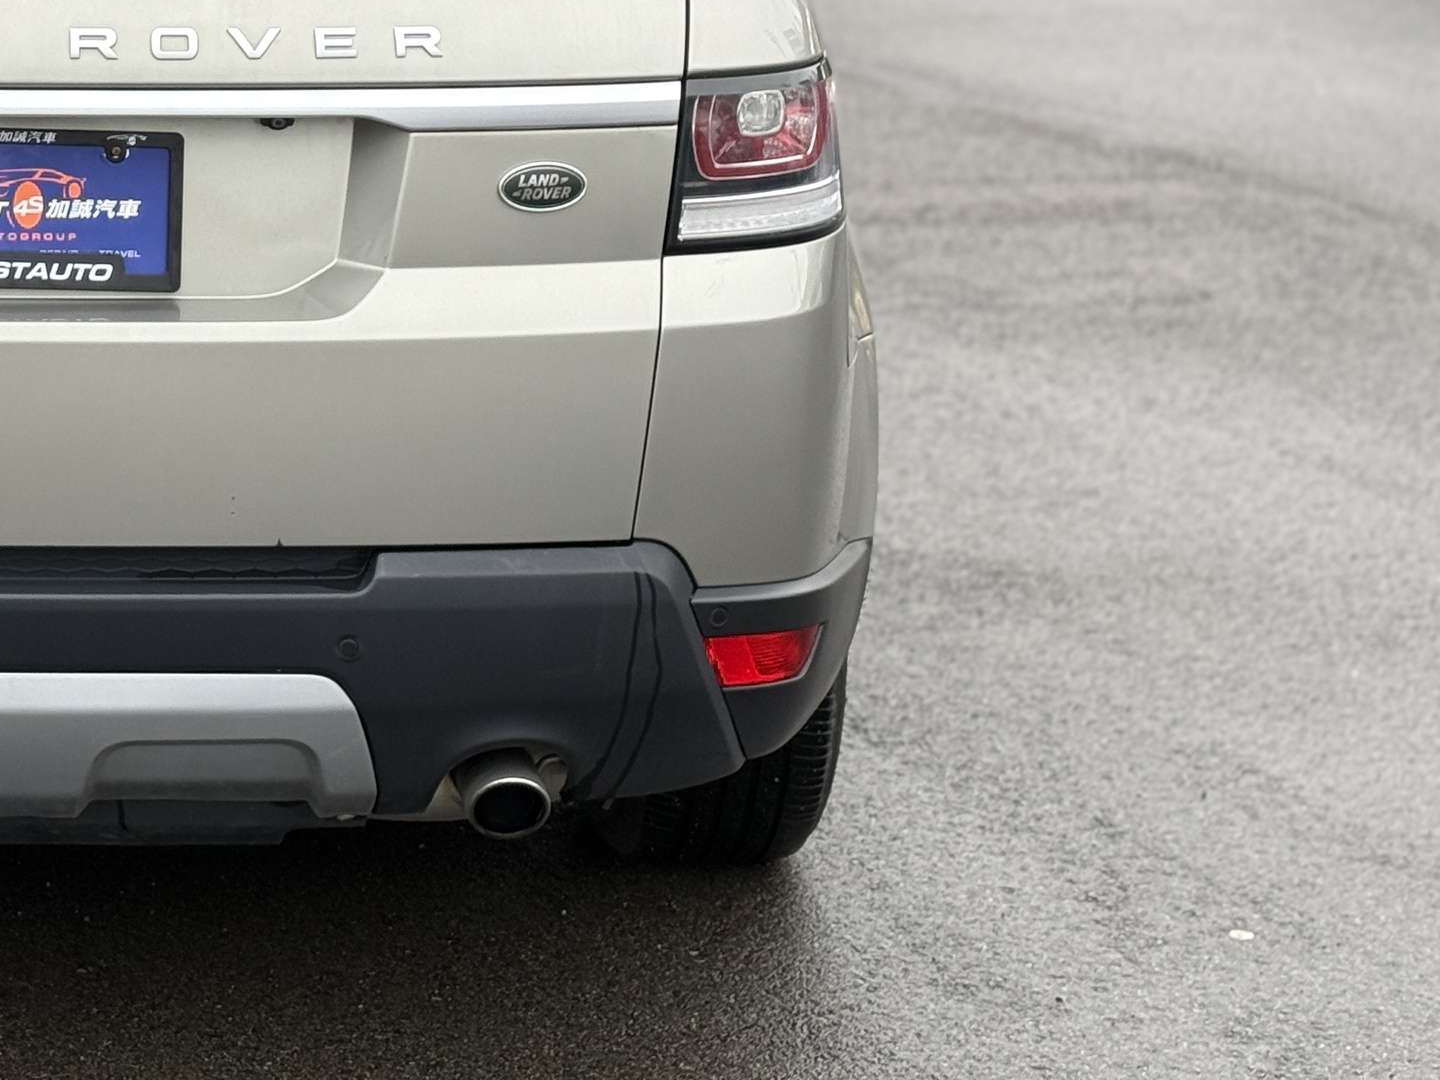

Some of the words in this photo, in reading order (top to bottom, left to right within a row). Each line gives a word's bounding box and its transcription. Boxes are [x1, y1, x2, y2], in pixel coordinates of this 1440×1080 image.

[68, 25, 444, 62] ROVER
[518, 173, 560, 187] LAND
[521, 186, 572, 200] ROVER
[46, 199, 142, 219] 加誠汽車
